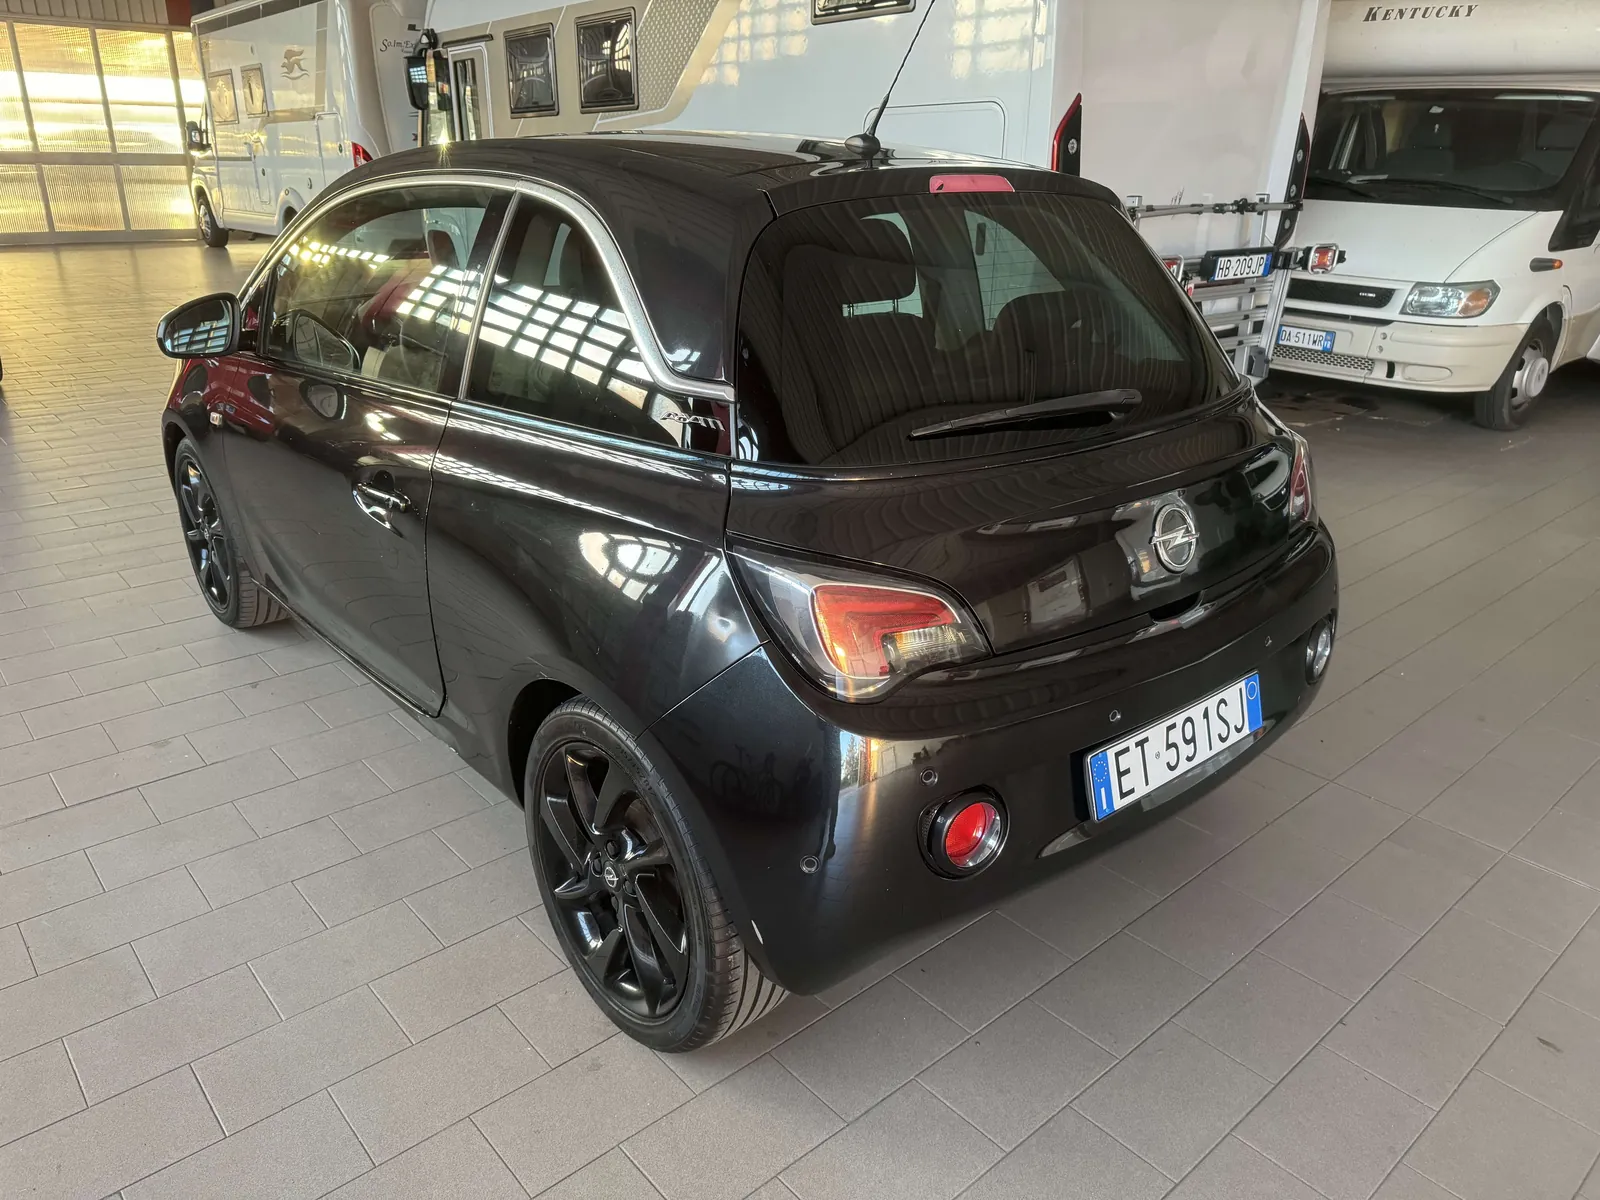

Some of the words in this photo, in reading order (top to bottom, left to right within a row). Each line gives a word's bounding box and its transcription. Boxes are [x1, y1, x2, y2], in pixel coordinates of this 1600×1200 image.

[1362, 5, 1478, 22] KENTUCKY
[1217, 259, 1232, 278] HB
[1233, 256, 1265, 277] 209JP
[1280, 329, 1292, 343] DA
[1294, 331, 1324, 347] 511WR
[1114, 735, 1150, 801] ET
[1164, 687, 1247, 772] 591SJ
